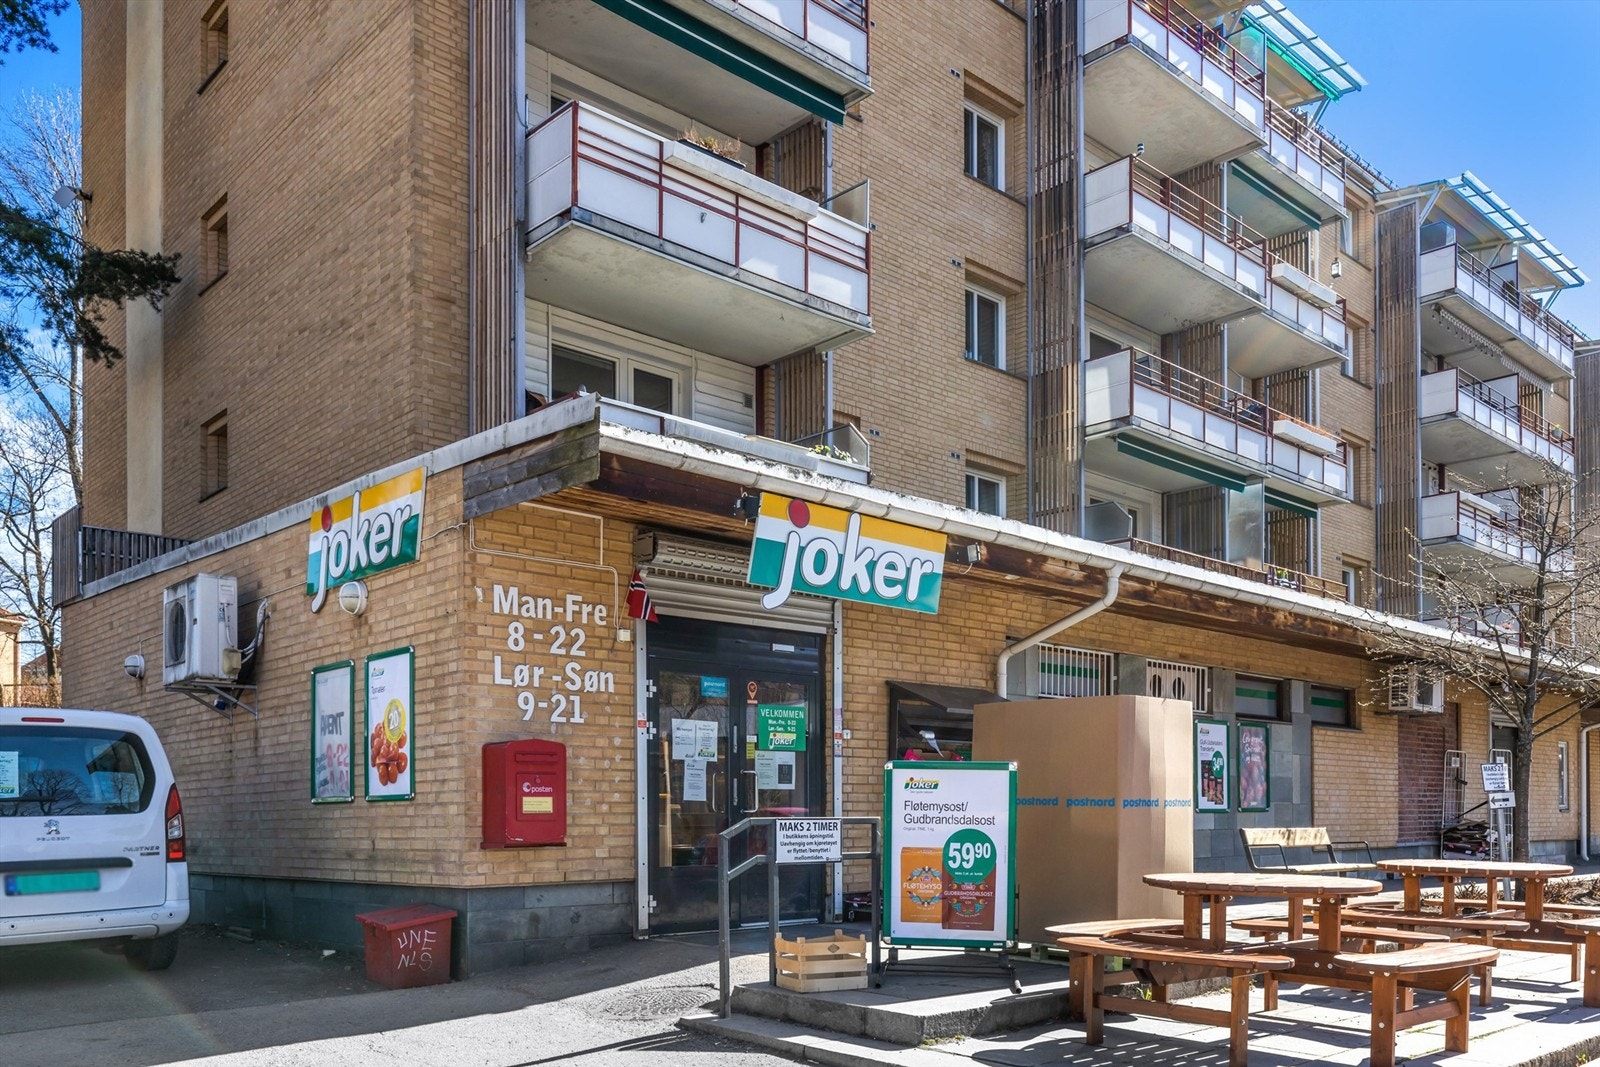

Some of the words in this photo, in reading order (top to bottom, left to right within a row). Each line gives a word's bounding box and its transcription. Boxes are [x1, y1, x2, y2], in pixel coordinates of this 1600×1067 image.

[311, 490, 412, 613] joker
[761, 499, 934, 610] joker
[493, 584, 607, 625] Man-Fre
[517, 691, 584, 724] 9-21
[760, 708, 804, 719] VELKOMMEN
[768, 733, 794, 750] joker
[531, 786, 553, 794] posten
[904, 777, 937, 791] joker
[904, 800, 968, 814] Fløtemysost/
[1066, 797, 1115, 808] postnord
[1122, 797, 1159, 809] postnord
[1164, 798, 1192, 808] postnord
[779, 821, 804, 831] MAKS
[806, 822, 812, 831] 2
[812, 821, 838, 831] TIMER
[903, 813, 995, 826] Gudbrandsdalsost
[397, 930, 437, 950] UNE
